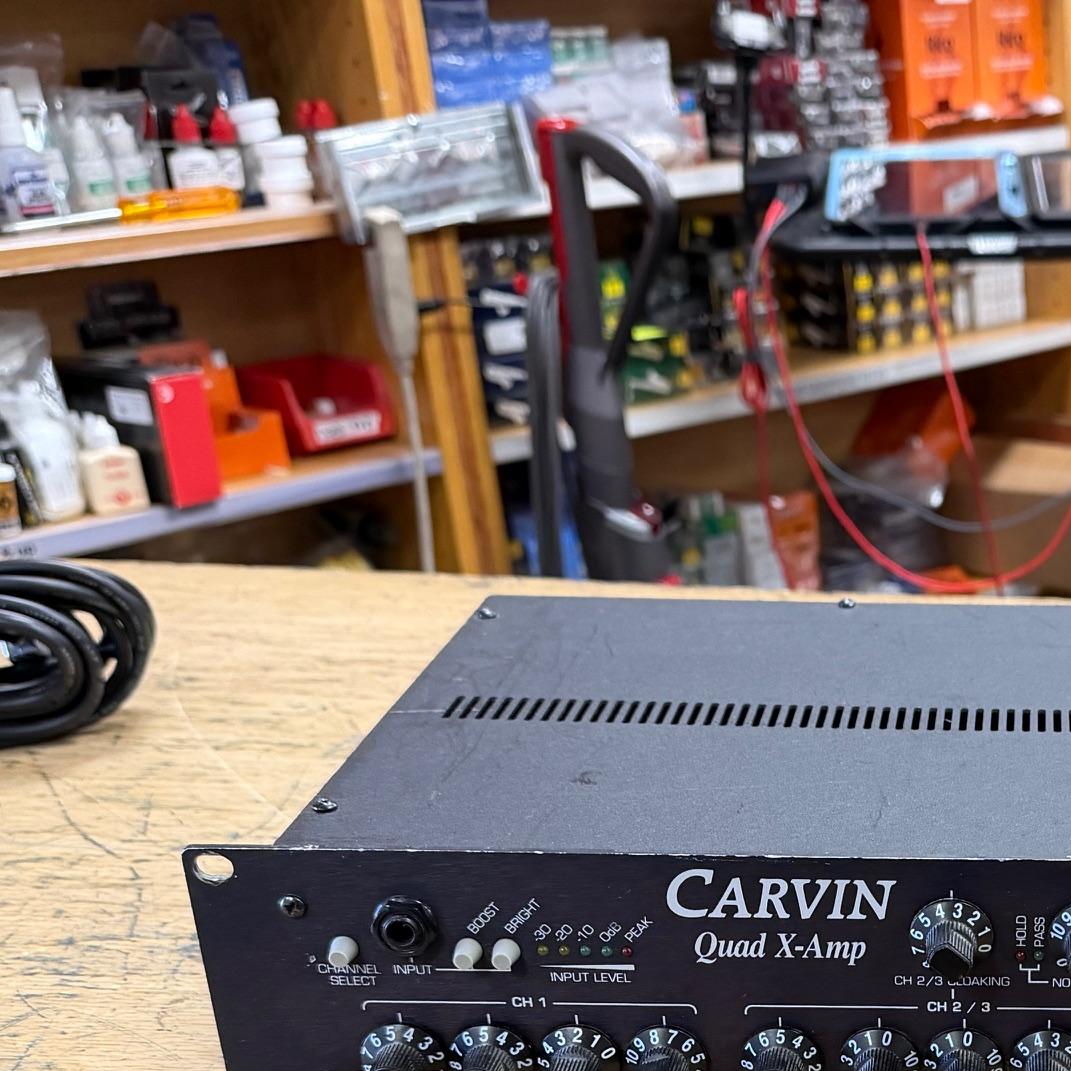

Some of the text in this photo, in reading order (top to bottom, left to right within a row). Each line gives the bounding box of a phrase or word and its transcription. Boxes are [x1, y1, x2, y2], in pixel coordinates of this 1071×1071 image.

[666, 868, 897, 920] CARVIN
[467, 901, 500, 935] BOOST
[504, 898, 541, 934] BRIGHT
[554, 924, 573, 942] -20
[577, 924, 594, 942] -10
[624, 916, 653, 942] PEAK
[910, 903, 981, 940] 6 5 4 3 2
[1016, 916, 1026, 946] HOLD
[1034, 917, 1045, 947] PASS
[694, 932, 866, 966] Quad X-Amp
[318, 964, 382, 974] CHANNEL
[330, 976, 376, 986] SELECT
[393, 964, 432, 975] INPUT
[550, 972, 632, 983] INPUT LEVEL
[894, 976, 912, 986] CH
[917, 976, 943, 986] 2/3
[512, 997, 546, 1007] CH 1
[927, 1002, 947, 1012] CH
[953, 1002, 962, 1012] 2
[981, 1002, 990, 1012] 3
[370, 1026, 433, 1051] 6 5 4 3
[450, 1027, 525, 1057] 7 6 5 4 3
[554, 1028, 616, 1060] 3 2 1 0
[634, 1029, 705, 1064] 9 8 7 6 5
[744, 1030, 803, 1057] 7 6 5 4
[841, 1031, 892, 1066] 3 2 1 0
[924, 1032, 973, 1069] 3 2 1 0
[1018, 1042, 1030, 1056] 5
[1034, 1033, 1044, 1047] 4
[1050, 1033, 1060, 1047] 3
